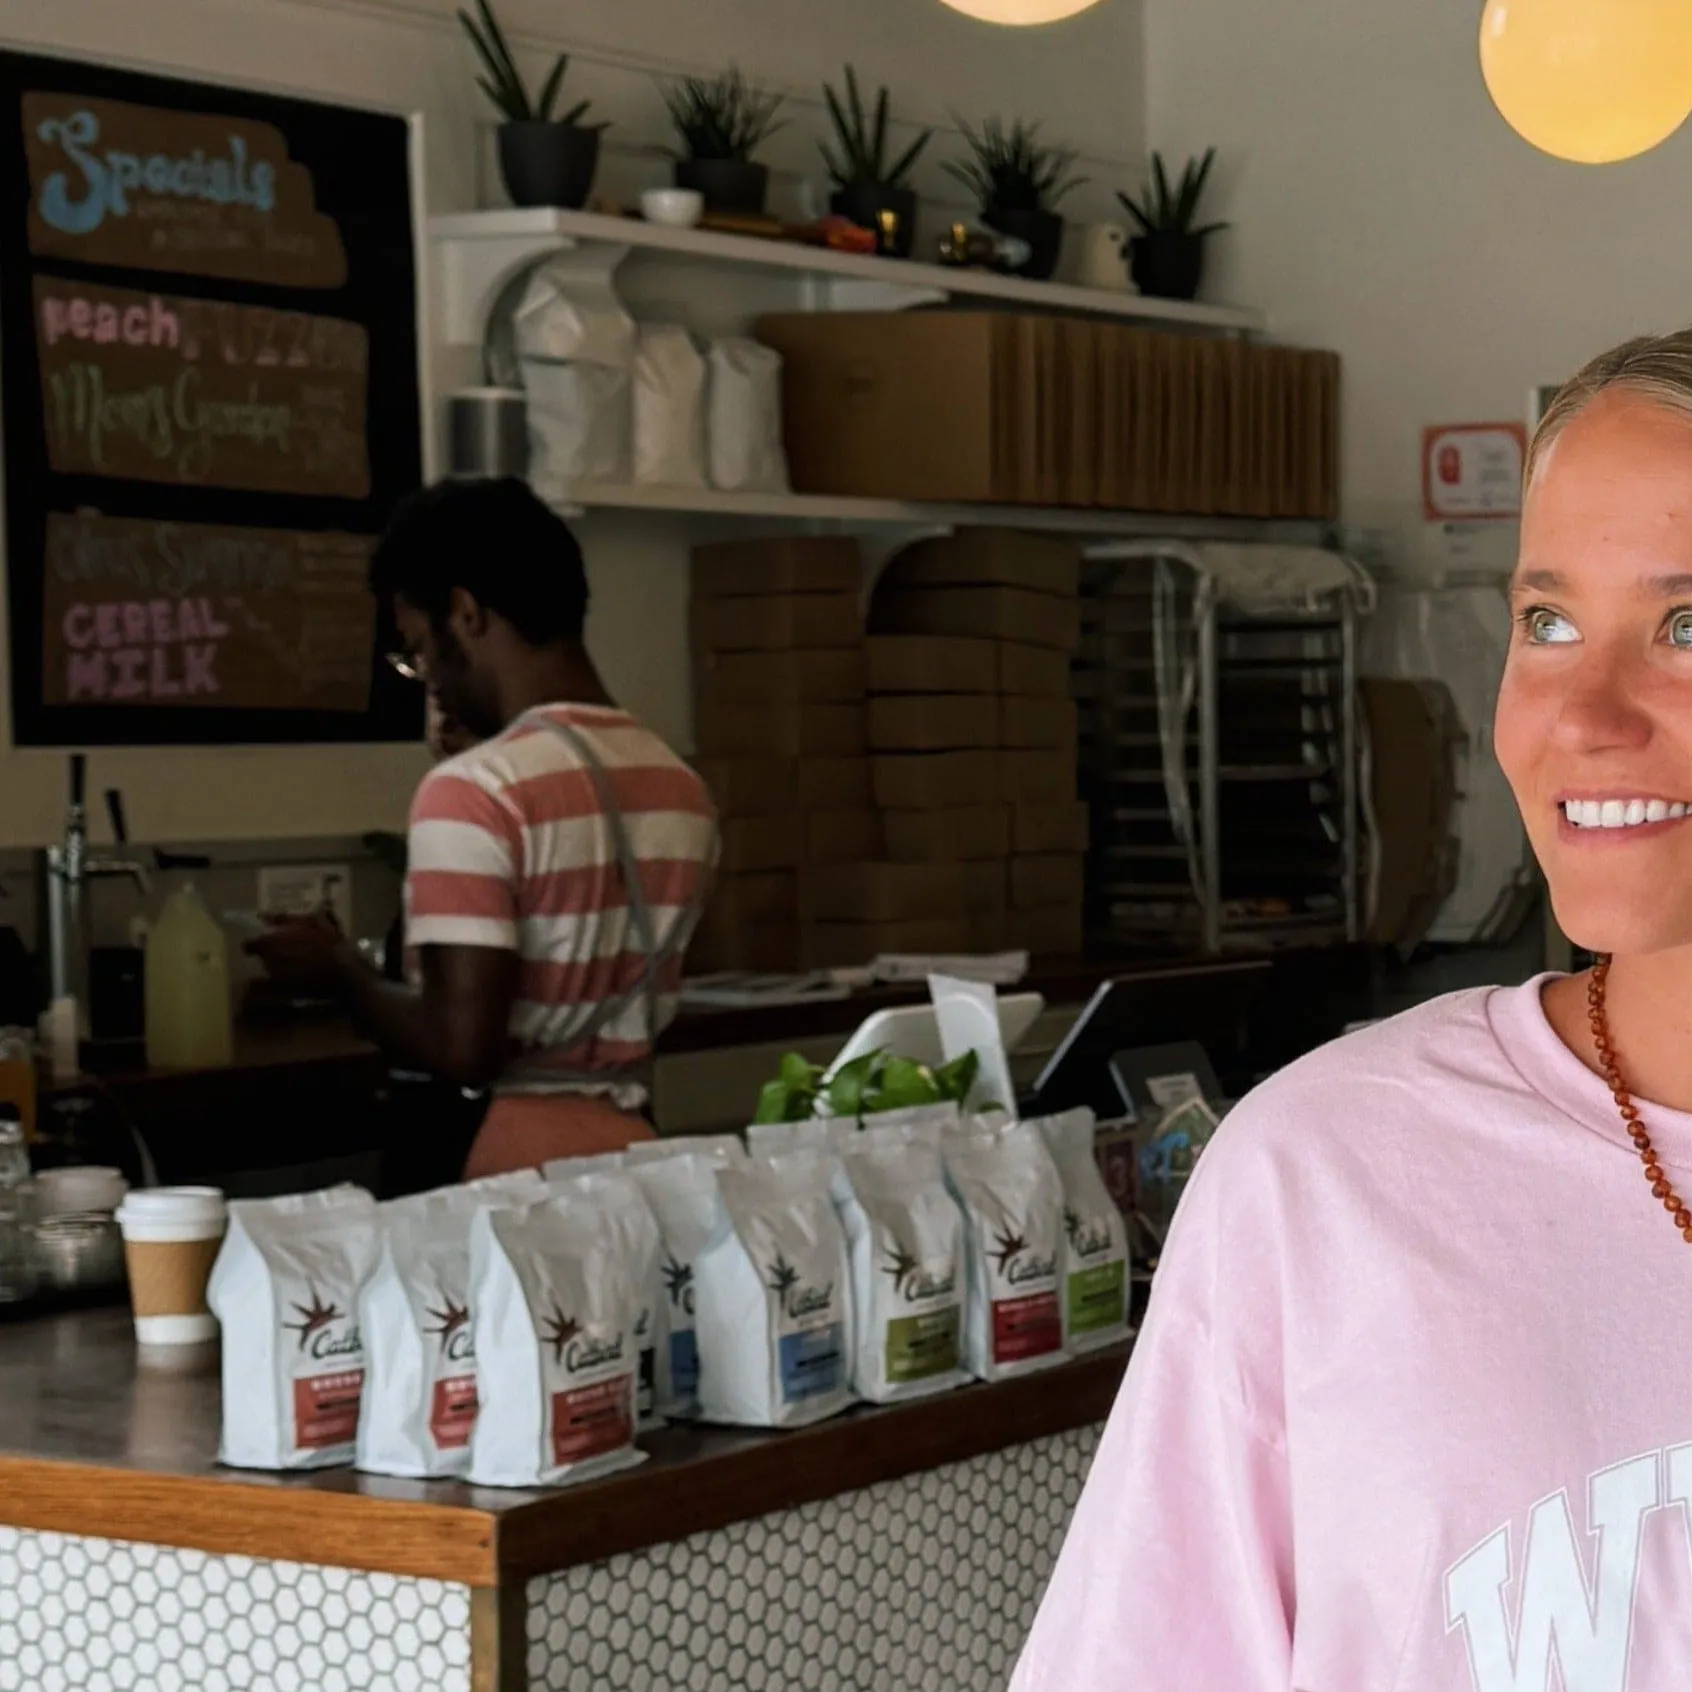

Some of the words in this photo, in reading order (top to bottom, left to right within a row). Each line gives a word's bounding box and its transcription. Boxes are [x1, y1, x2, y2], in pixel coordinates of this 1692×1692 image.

[37, 110, 274, 234] Specials
[62, 598, 231, 650] CEREAL
[66, 644, 219, 702] MILK
